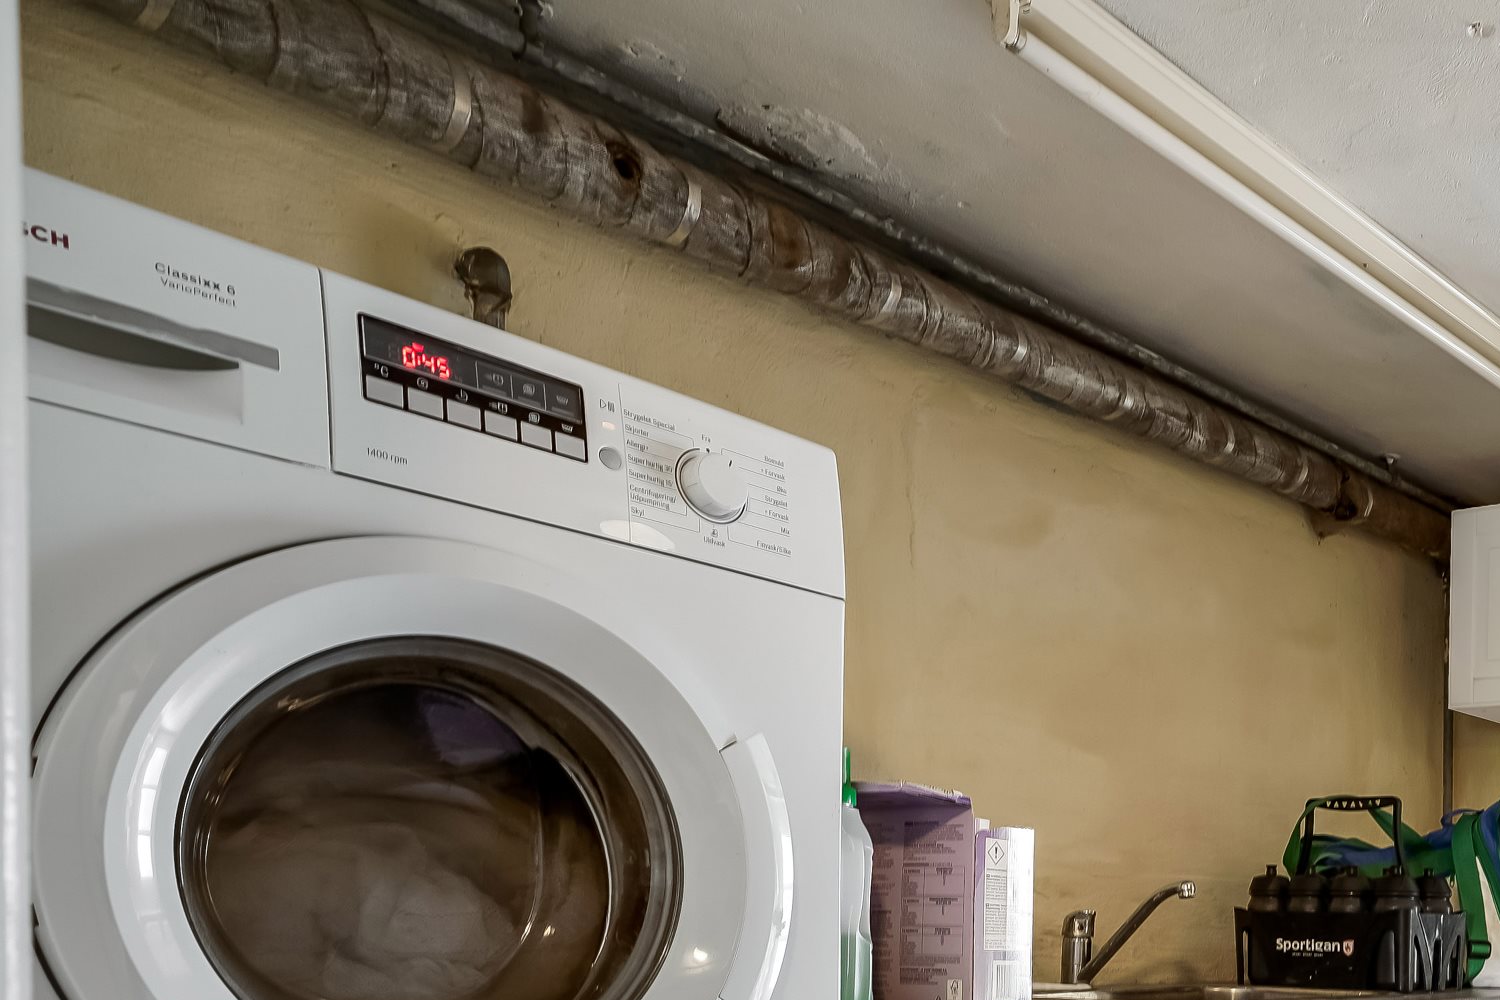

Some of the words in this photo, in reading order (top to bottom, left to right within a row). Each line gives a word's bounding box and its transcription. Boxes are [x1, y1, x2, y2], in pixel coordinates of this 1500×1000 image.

[155, 262, 220, 292] Classixx
[227, 285, 236, 296] 6
[160, 276, 236, 307] VarioPerfect
[367, 447, 389, 460] 1400
[390, 454, 408, 465] rpm
[1276, 937, 1341, 953] Sportigan
